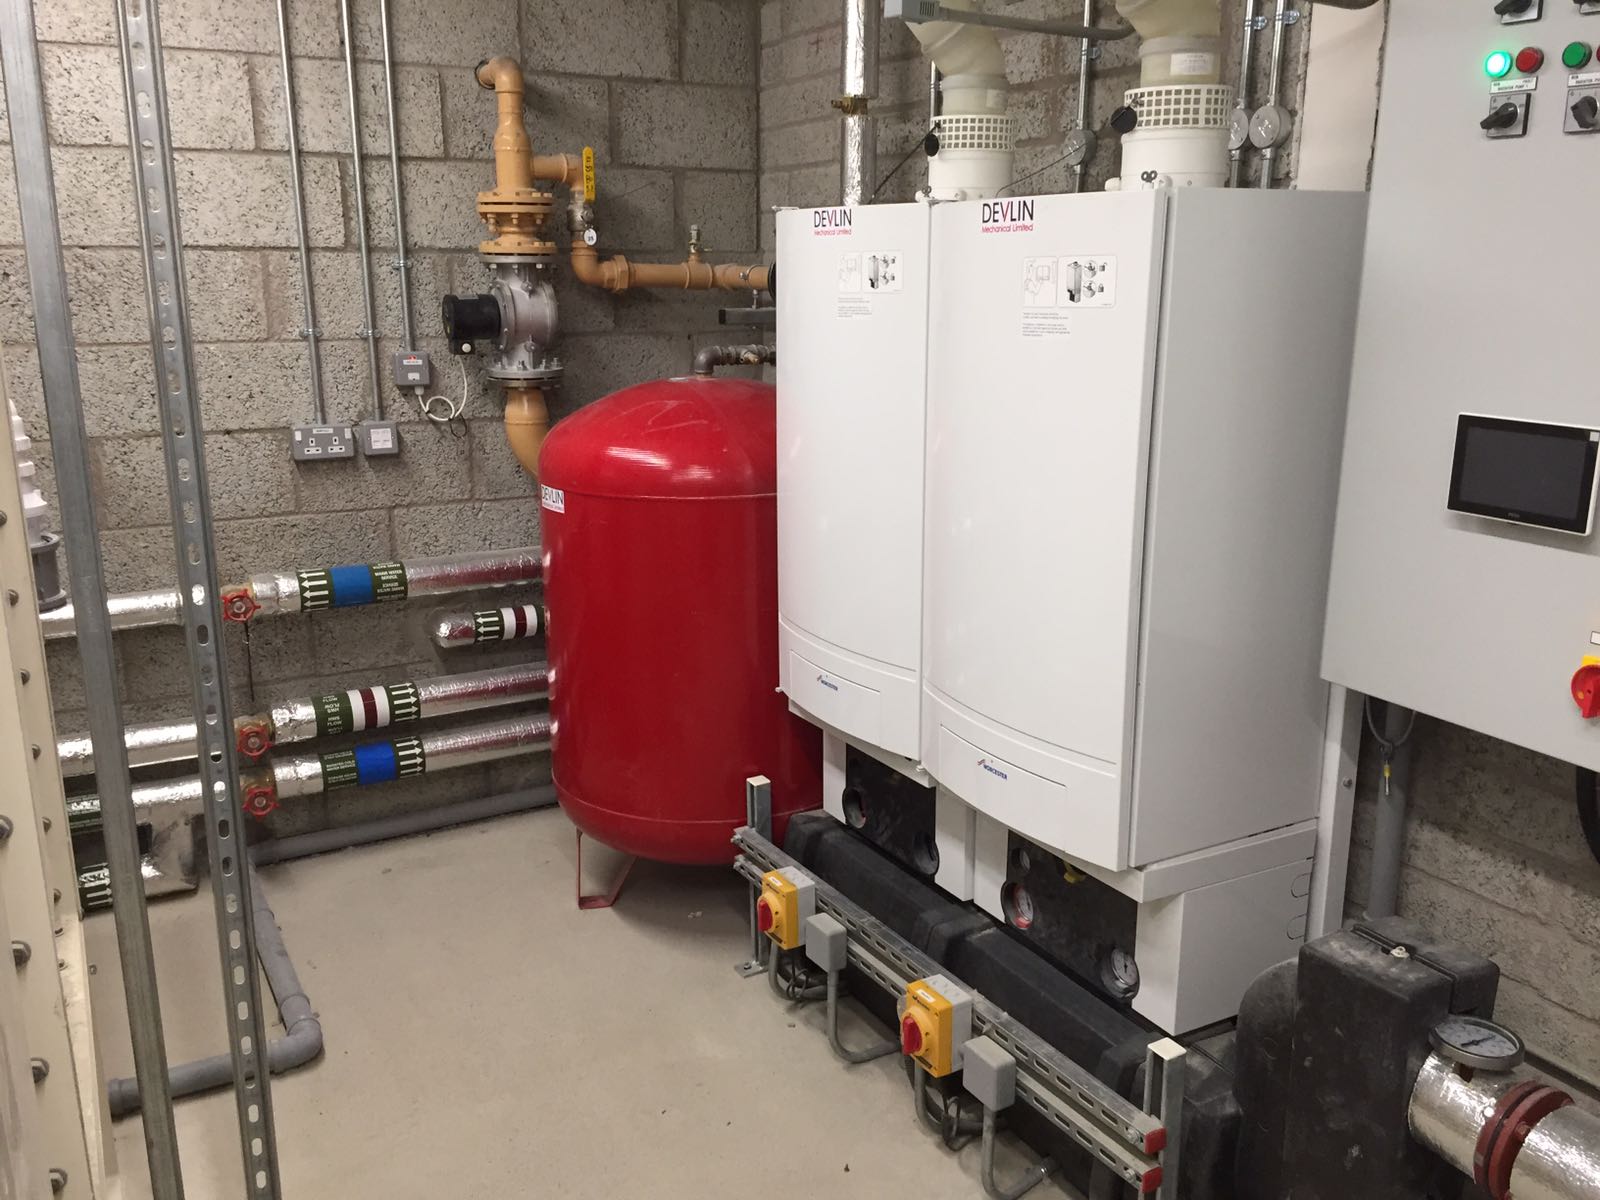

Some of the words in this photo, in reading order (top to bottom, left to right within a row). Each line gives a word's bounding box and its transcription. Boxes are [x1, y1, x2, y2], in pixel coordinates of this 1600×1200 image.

[814, 208, 852, 228] DEVLIN
[982, 199, 1034, 223] DEVLIN
[982, 224, 1011, 233] Mechanical
[1012, 223, 1034, 232] Limited
[983, 764, 1008, 781] WORCESTER
